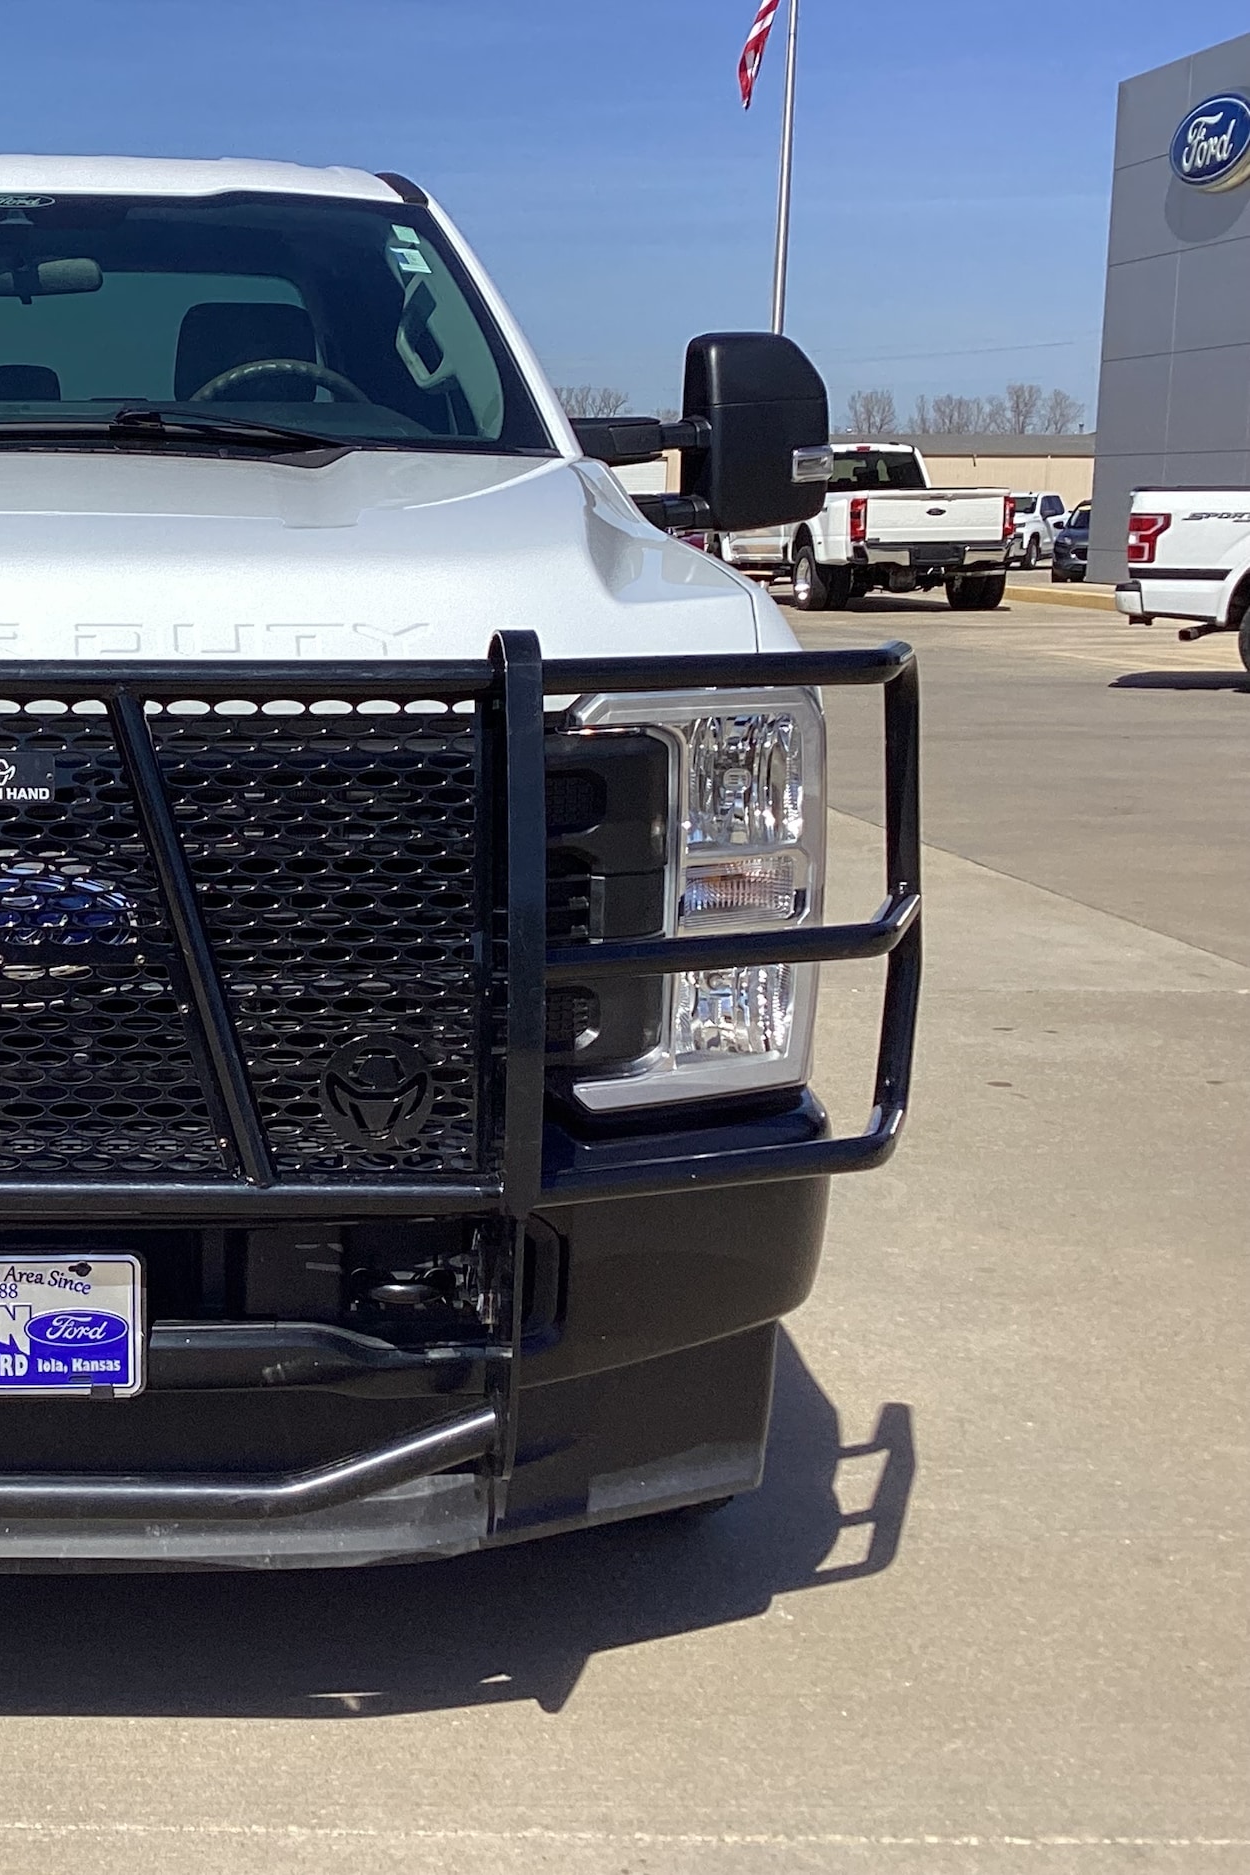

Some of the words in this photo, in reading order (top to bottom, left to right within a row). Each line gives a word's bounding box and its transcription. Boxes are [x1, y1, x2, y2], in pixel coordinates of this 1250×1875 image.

[1182, 111, 1236, 172] Ford
[75, 622, 430, 658] DUTY
[6, 787, 50, 800] HAND
[3, 1265, 44, 1285] Area
[47, 1270, 92, 1296] Since
[45, 1315, 108, 1341] Ford
[36, 1357, 68, 1374] Iola,
[71, 1357, 121, 1373] Kansas
